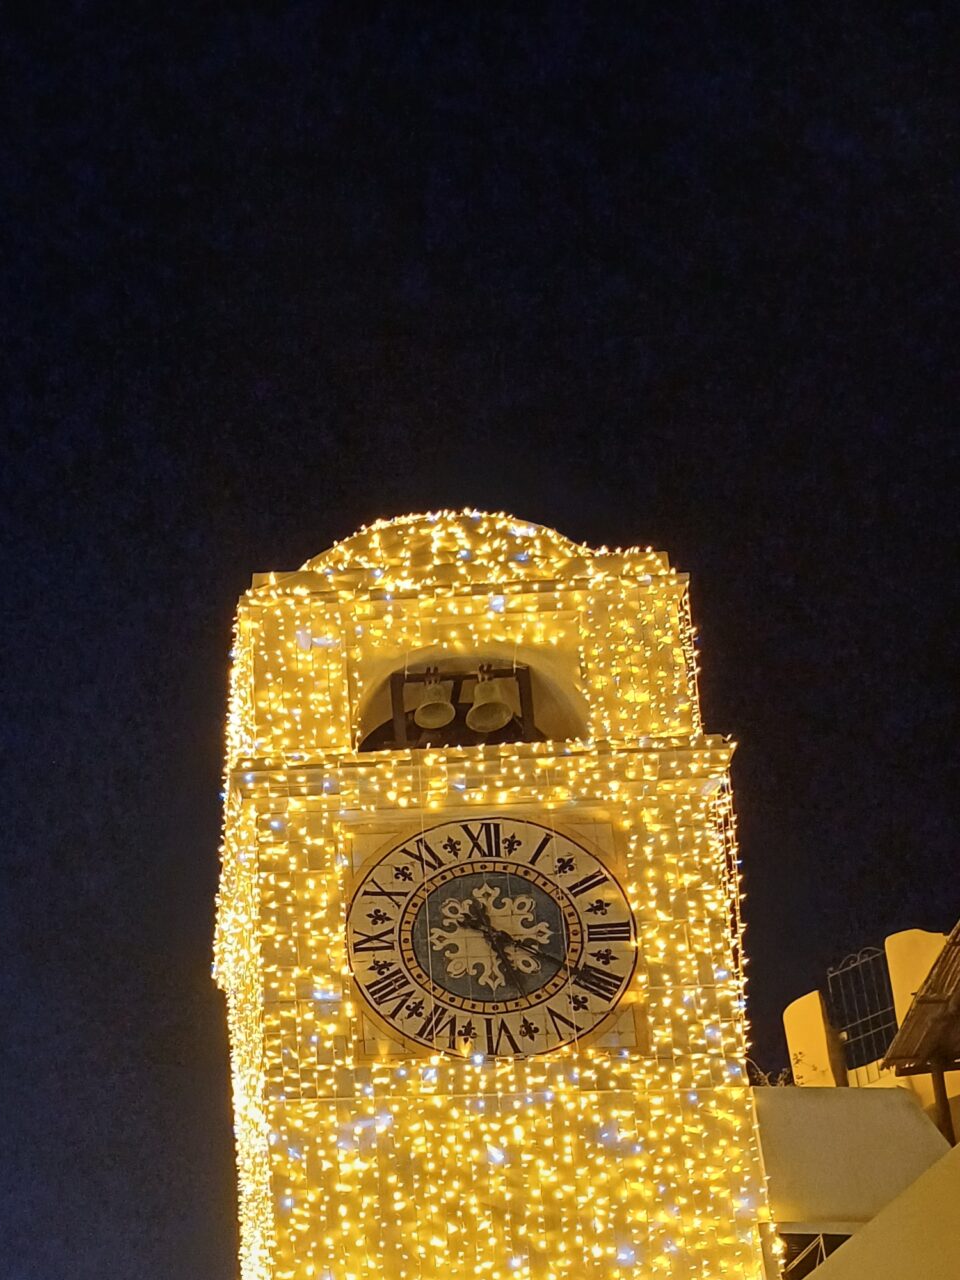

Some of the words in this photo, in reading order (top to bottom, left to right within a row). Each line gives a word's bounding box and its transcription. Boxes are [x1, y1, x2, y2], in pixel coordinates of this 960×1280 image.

[401, 837, 445, 871] XI
[460, 823, 501, 858] XII
[529, 833, 553, 865] I
[363, 879, 410, 908] X
[570, 868, 610, 898] II
[353, 928, 395, 953] IX
[587, 920, 631, 942] III
[365, 968, 416, 1020] VIII
[416, 1004, 457, 1050] VII
[485, 1017, 522, 1056] VI
[547, 1006, 583, 1042] V
